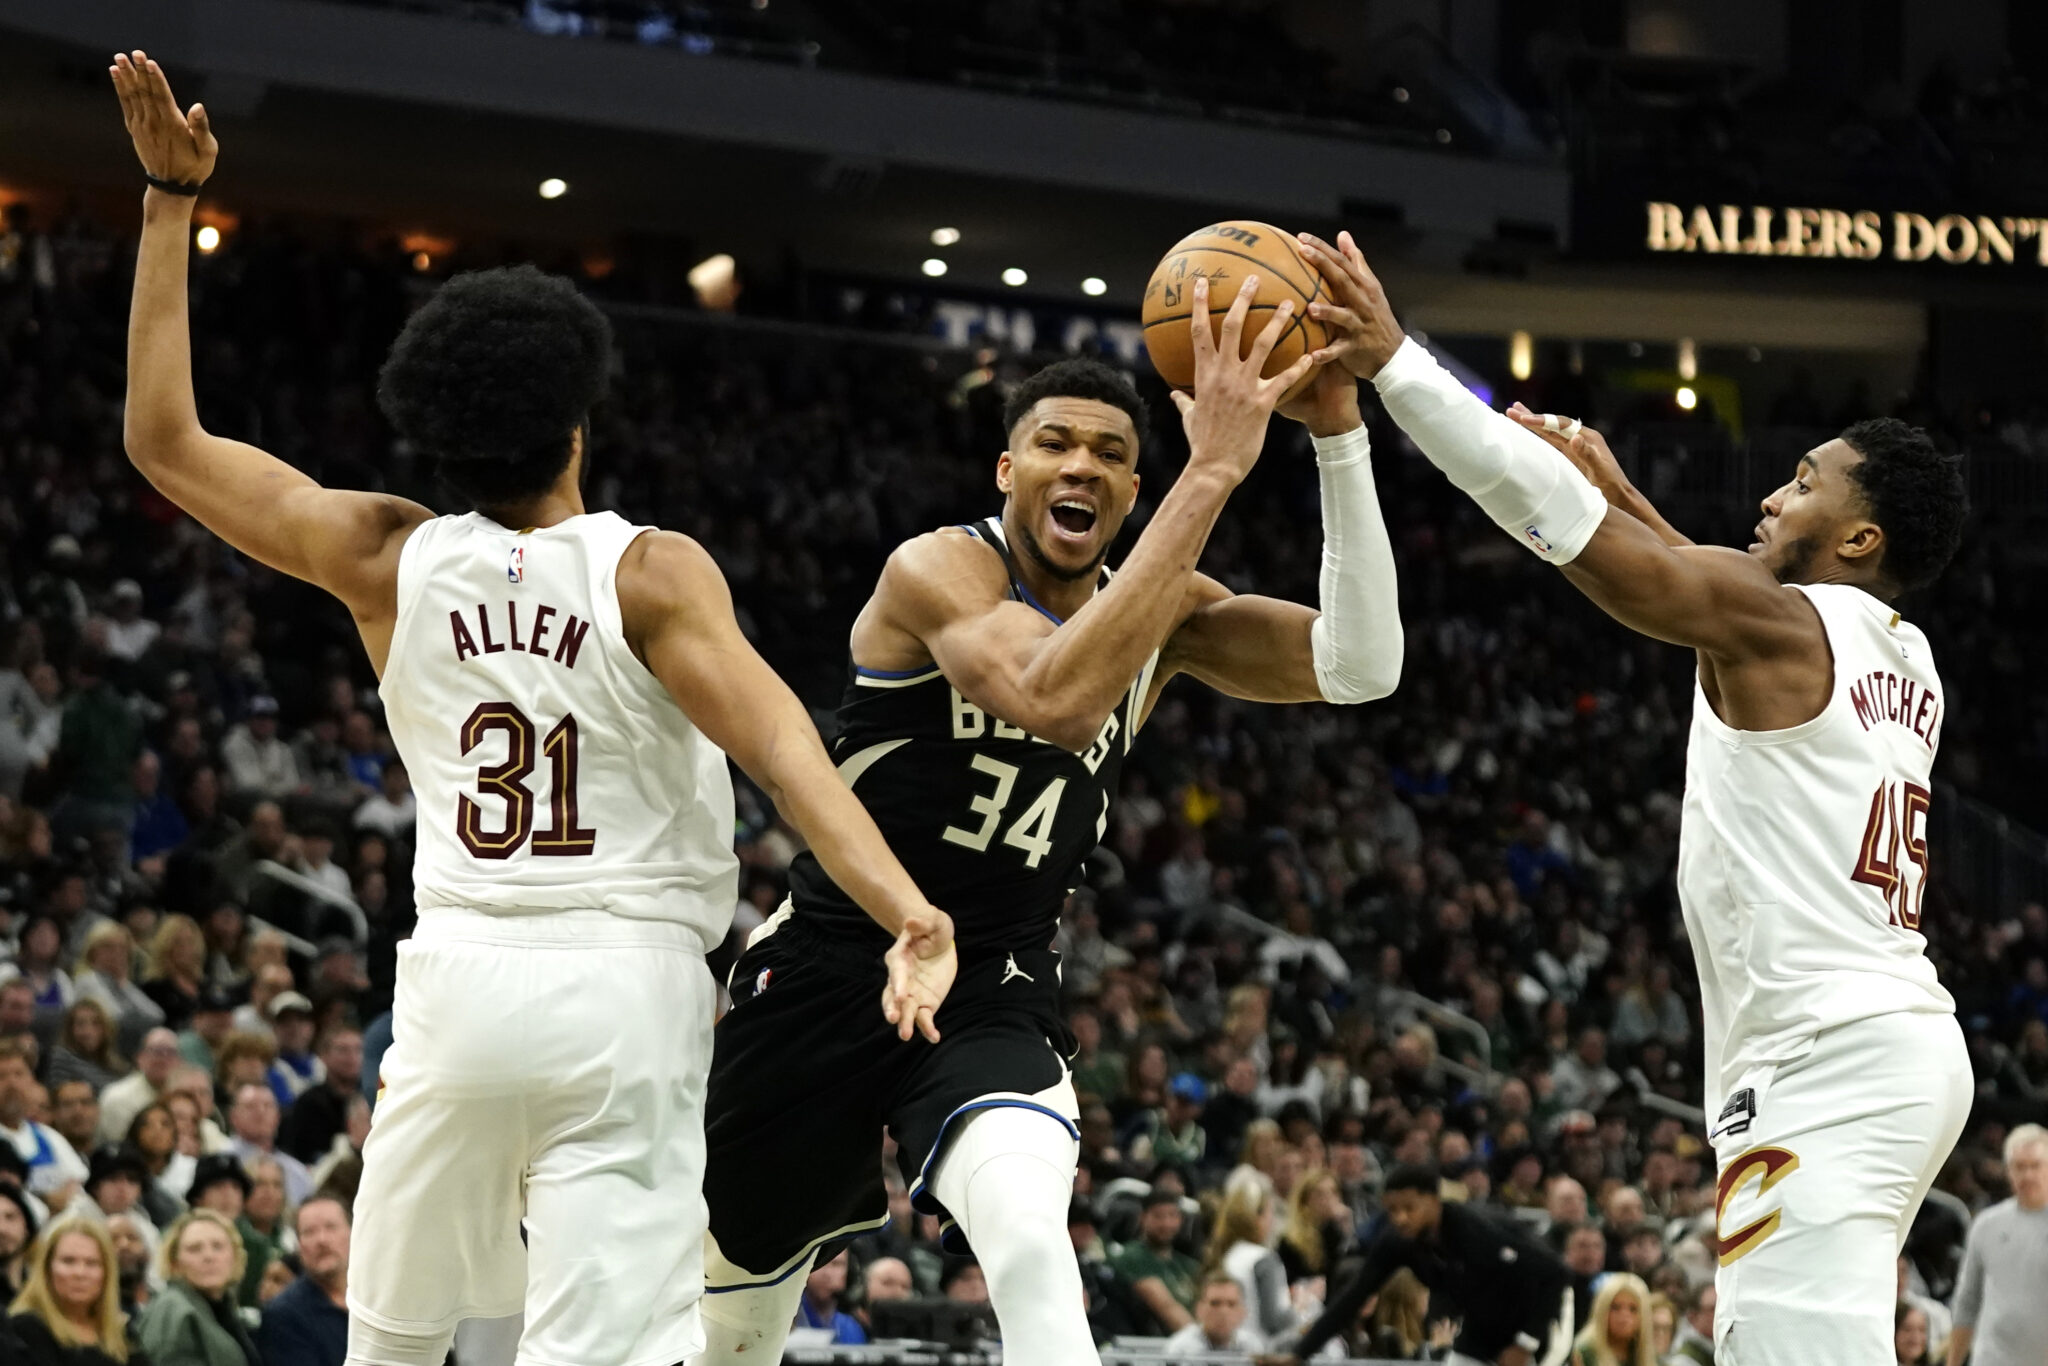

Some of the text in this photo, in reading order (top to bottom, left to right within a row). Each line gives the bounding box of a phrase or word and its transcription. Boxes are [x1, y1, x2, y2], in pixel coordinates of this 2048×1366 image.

[1647, 202, 1882, 259] BALLERS
[450, 600, 590, 669] ALLEN
[1850, 671, 1940, 752] MITCHEL
[456, 701, 597, 860] 31
[941, 752, 1069, 869] 34
[1850, 777, 1931, 930] 45
